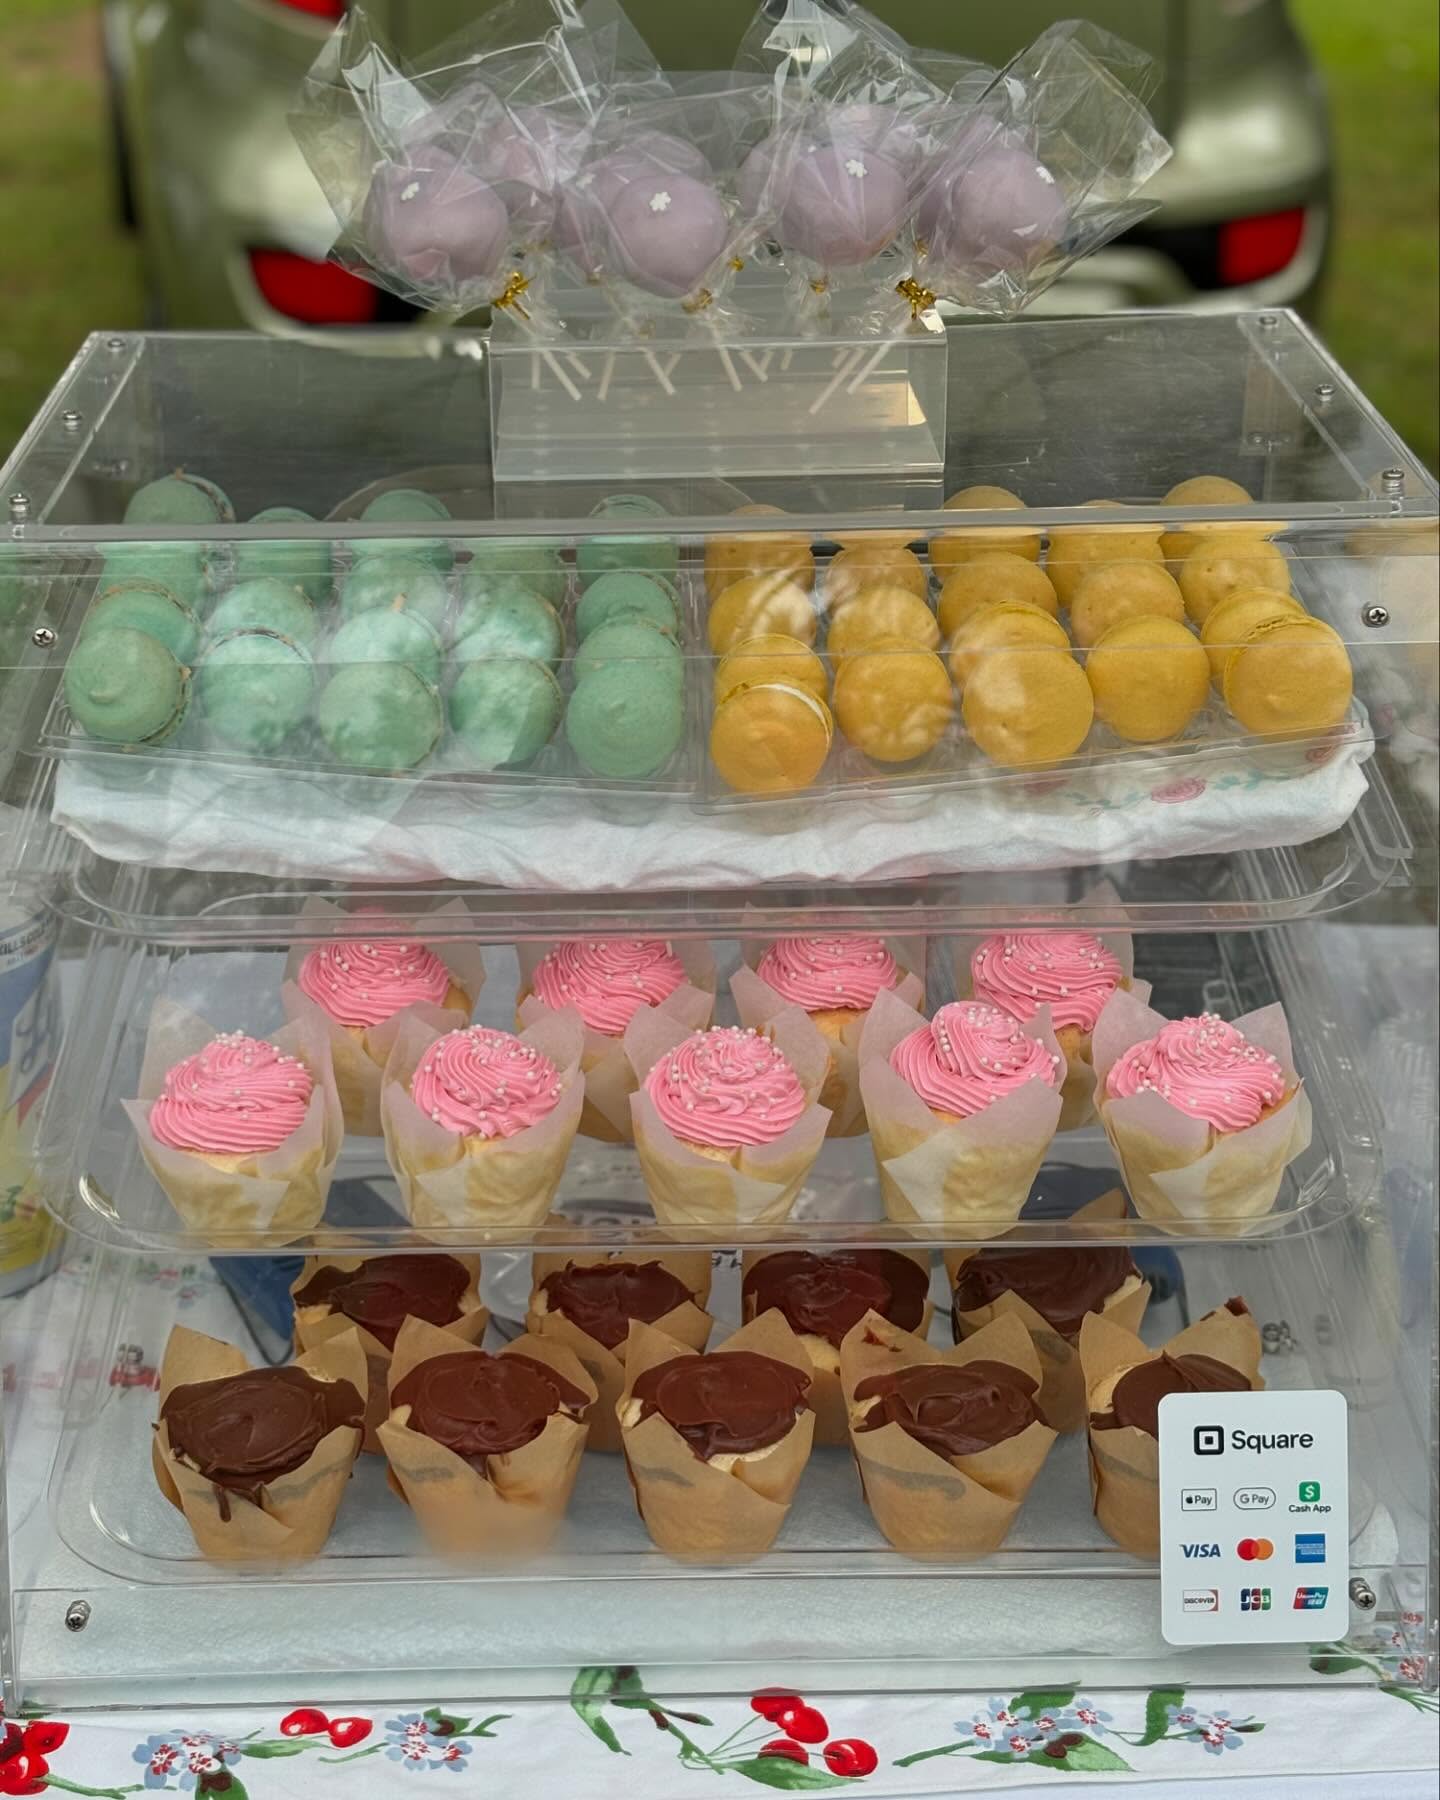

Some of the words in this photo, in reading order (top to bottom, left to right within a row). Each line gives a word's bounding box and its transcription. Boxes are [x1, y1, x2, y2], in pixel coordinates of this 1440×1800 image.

[1231, 1429, 1314, 1454] Square
[1194, 1495, 1213, 1506] Pay
[1239, 1493, 1250, 1504] G
[1252, 1494, 1270, 1505] Pay
[1288, 1504, 1311, 1513] Cash
[1312, 1504, 1332, 1513] App
[1179, 1543, 1221, 1558] VISA
